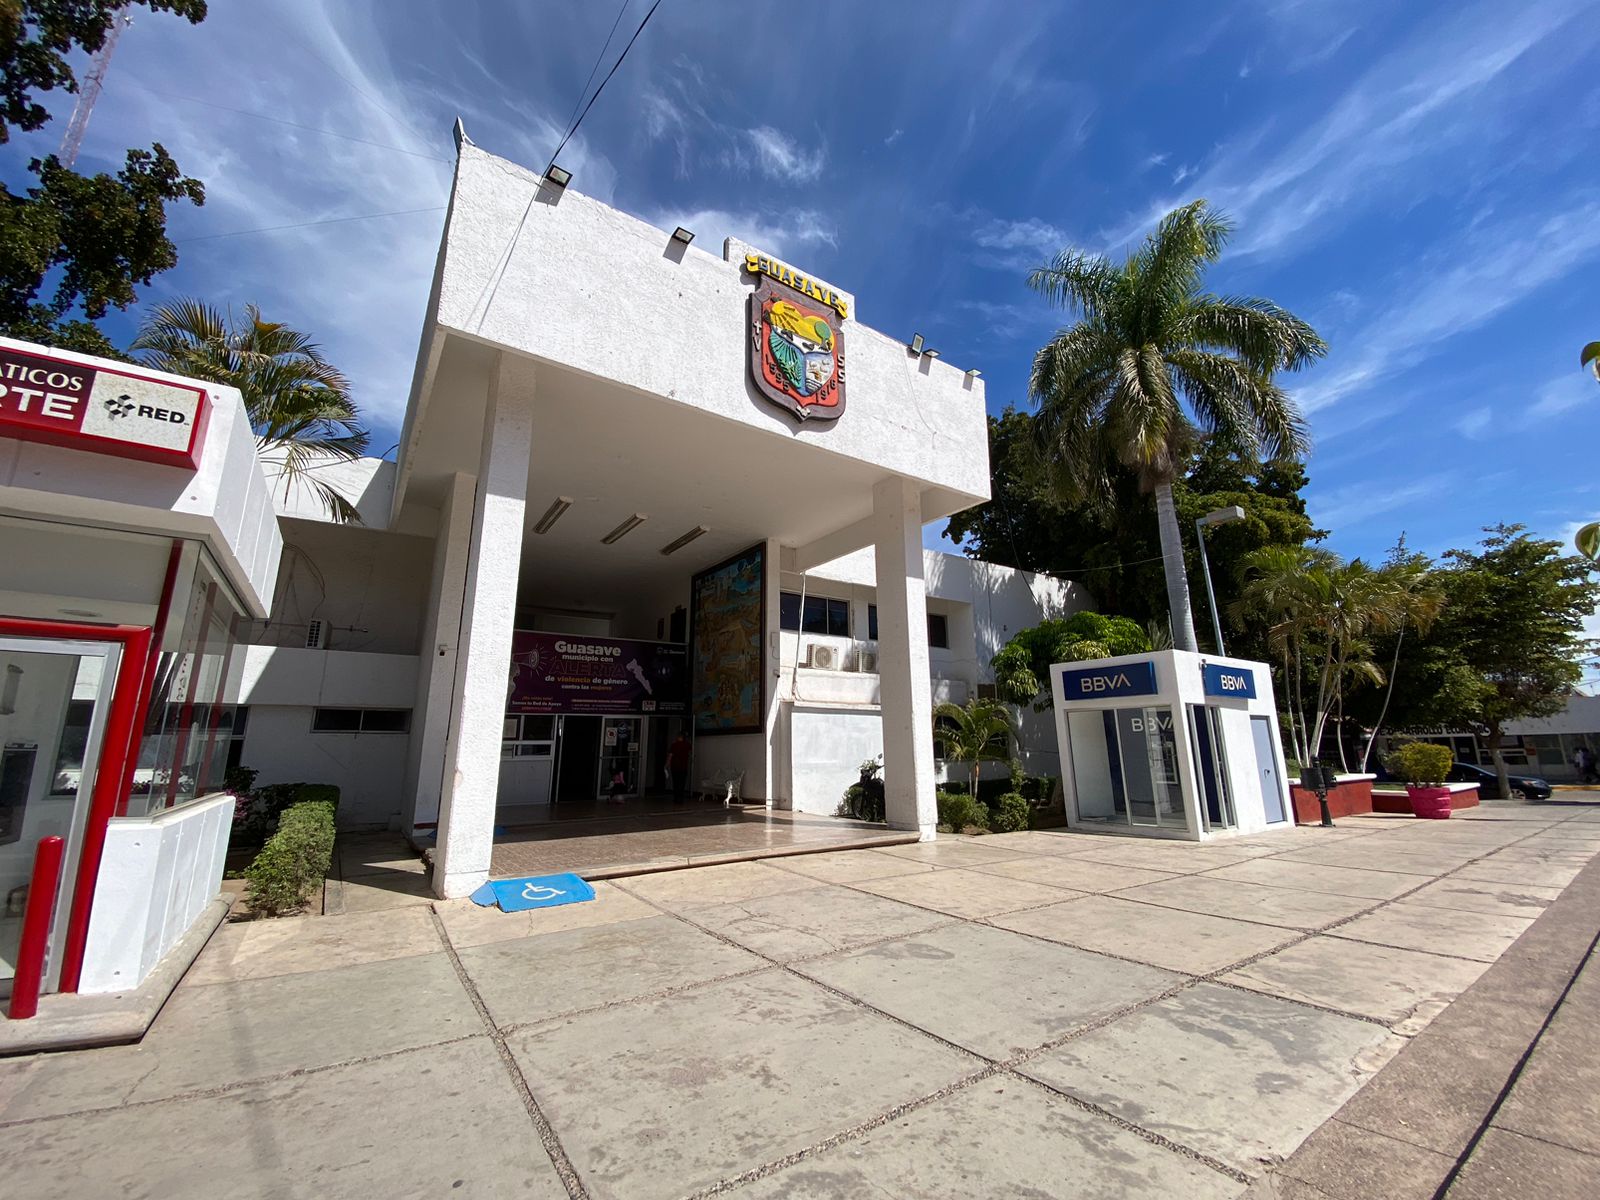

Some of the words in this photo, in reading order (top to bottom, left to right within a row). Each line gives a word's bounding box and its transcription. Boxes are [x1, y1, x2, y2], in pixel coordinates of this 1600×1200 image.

[758, 256, 839, 306] GUASAVE
[0, 383, 79, 420] TE
[138, 404, 185, 424] RED
[554, 640, 622, 657] Guasave
[561, 653, 599, 662] municipio
[544, 674, 555, 682] de
[557, 675, 591, 684] violencia
[592, 676, 602, 684] de
[603, 677, 629, 686] género
[1080, 672, 1131, 693] BBVA
[1220, 674, 1247, 690] BBVA
